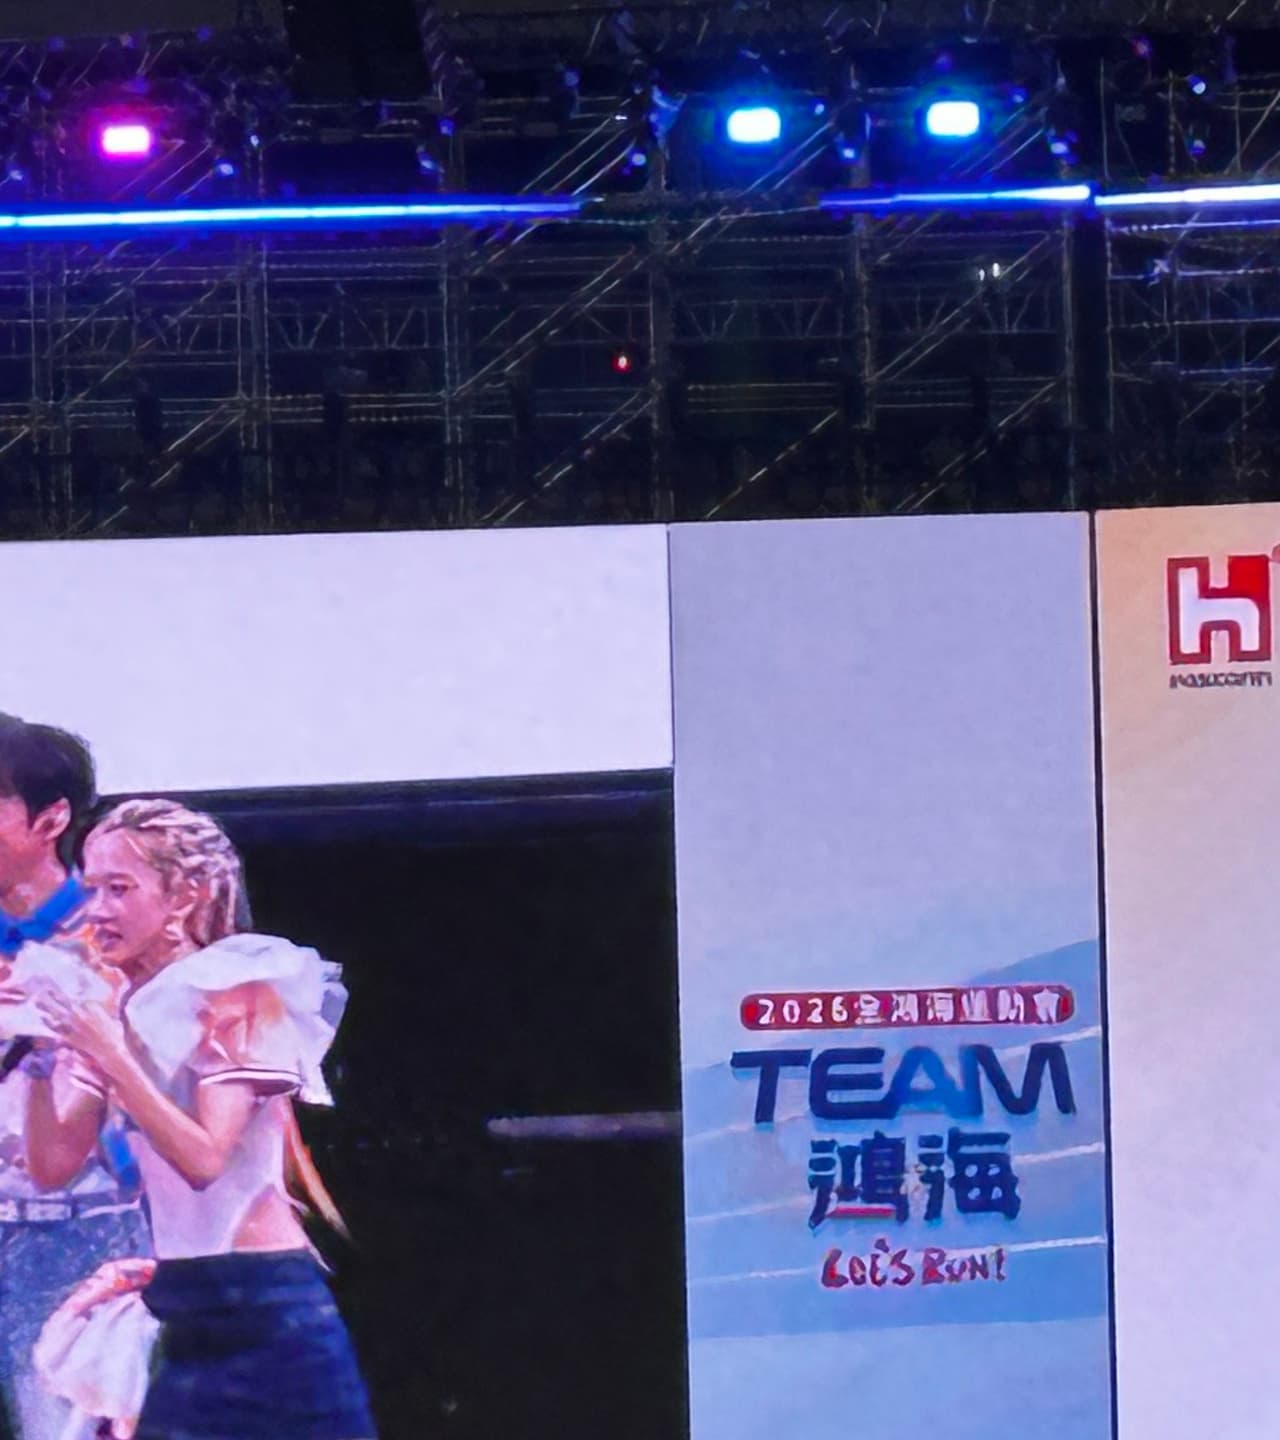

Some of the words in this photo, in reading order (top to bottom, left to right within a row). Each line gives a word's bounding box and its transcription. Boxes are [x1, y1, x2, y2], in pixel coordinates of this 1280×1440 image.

[730, 1041, 1077, 1123] TEAM
[808, 1127, 1021, 1228] 鴻海
[821, 1238, 916, 1288] Let's
